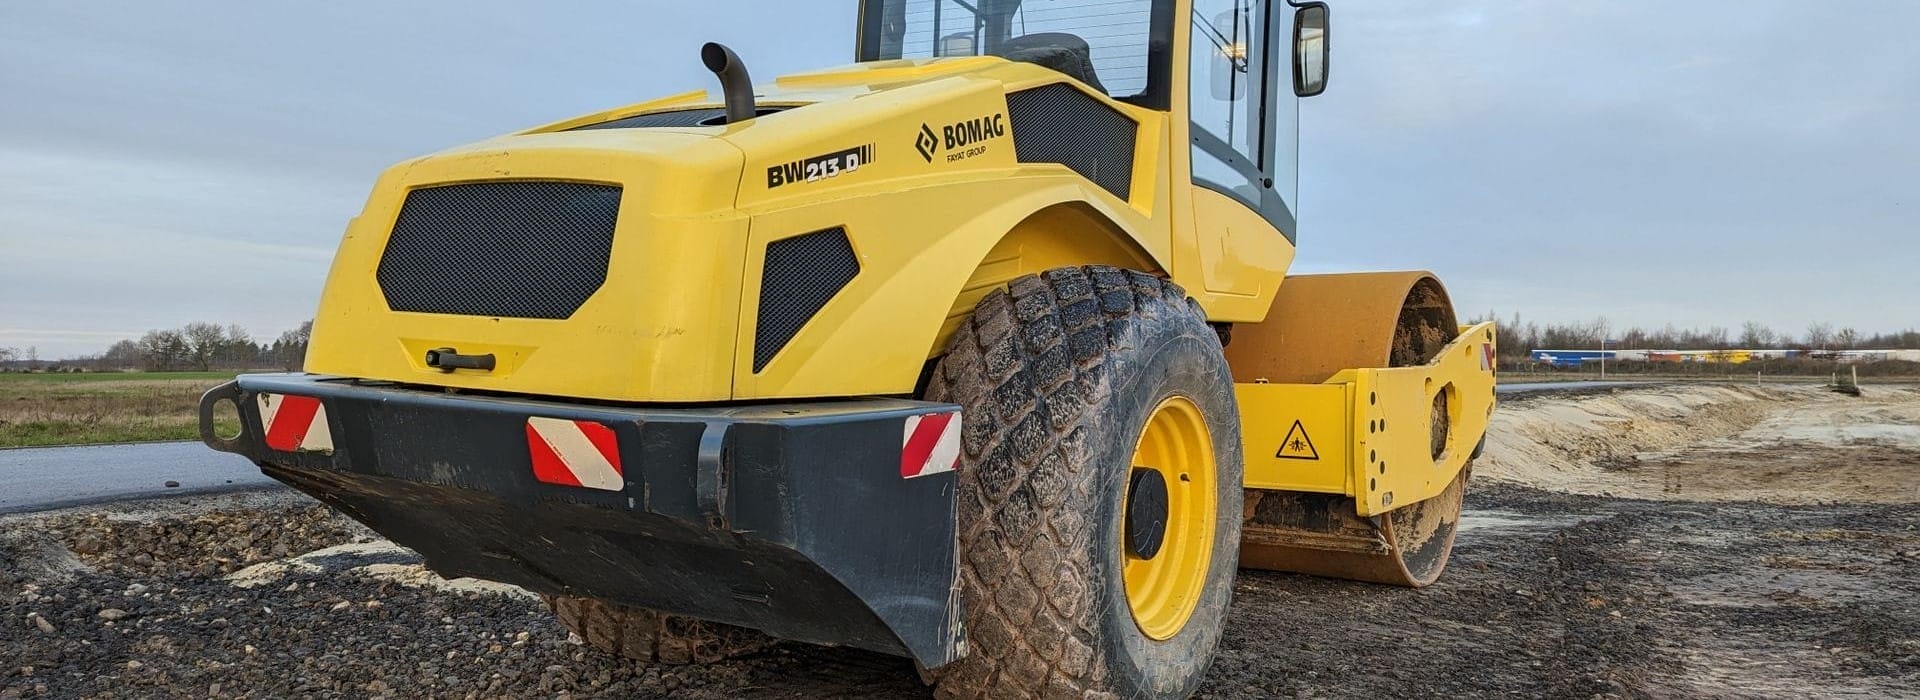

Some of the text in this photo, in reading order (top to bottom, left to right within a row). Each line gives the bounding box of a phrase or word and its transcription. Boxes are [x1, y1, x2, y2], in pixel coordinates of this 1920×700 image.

[943, 113, 1004, 150] BOMAG
[845, 153, 859, 173] D
[946, 145, 987, 163] FAYAT GROUP
